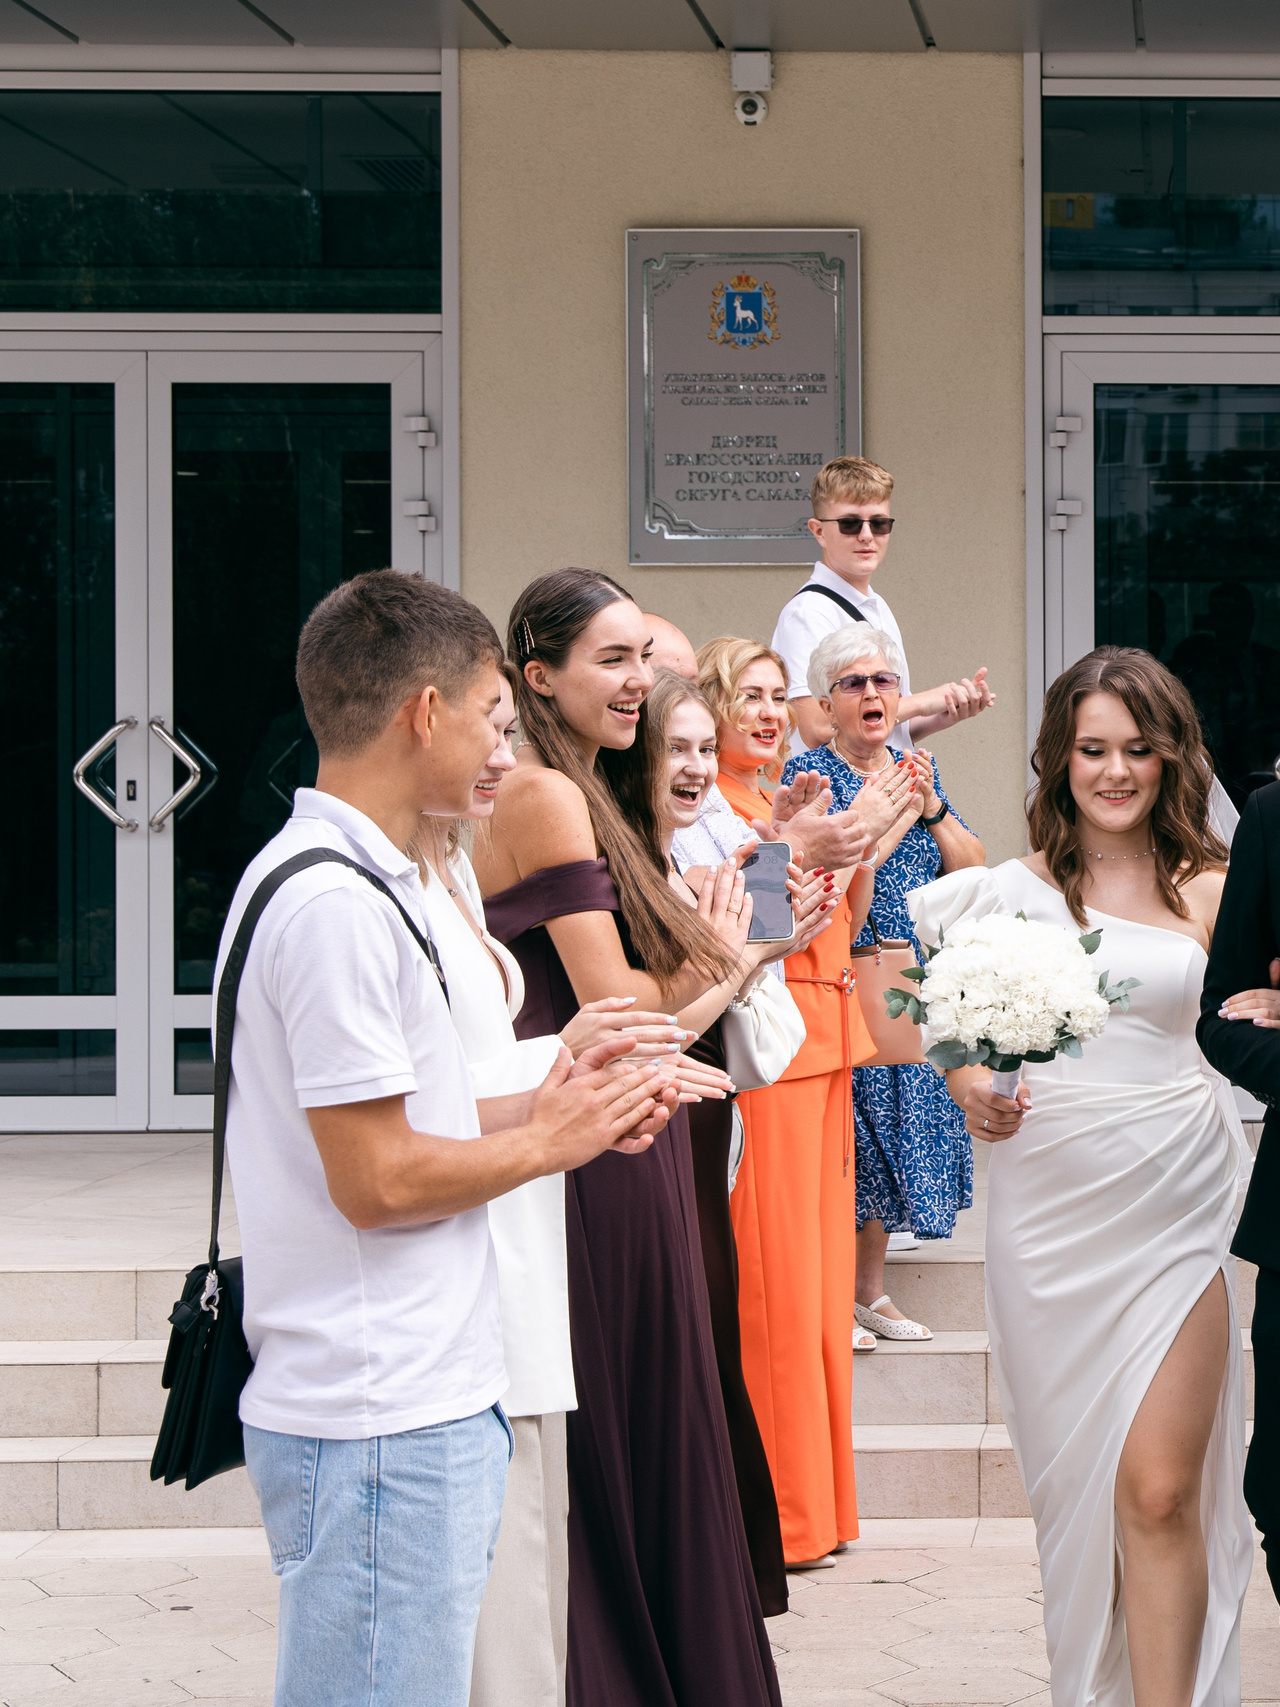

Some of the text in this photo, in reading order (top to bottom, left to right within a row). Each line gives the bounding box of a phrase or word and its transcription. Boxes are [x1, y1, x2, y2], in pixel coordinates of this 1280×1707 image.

[789, 373, 826, 383] АКТОВ
[711, 435, 778, 450] ДВОРЕЦ
[665, 453, 824, 467] БРАКОСОЧЕТАНИЯ
[688, 471, 801, 486] ГОРОДСКОГО
[675, 489, 812, 501] ОКРУГА САМАРА
